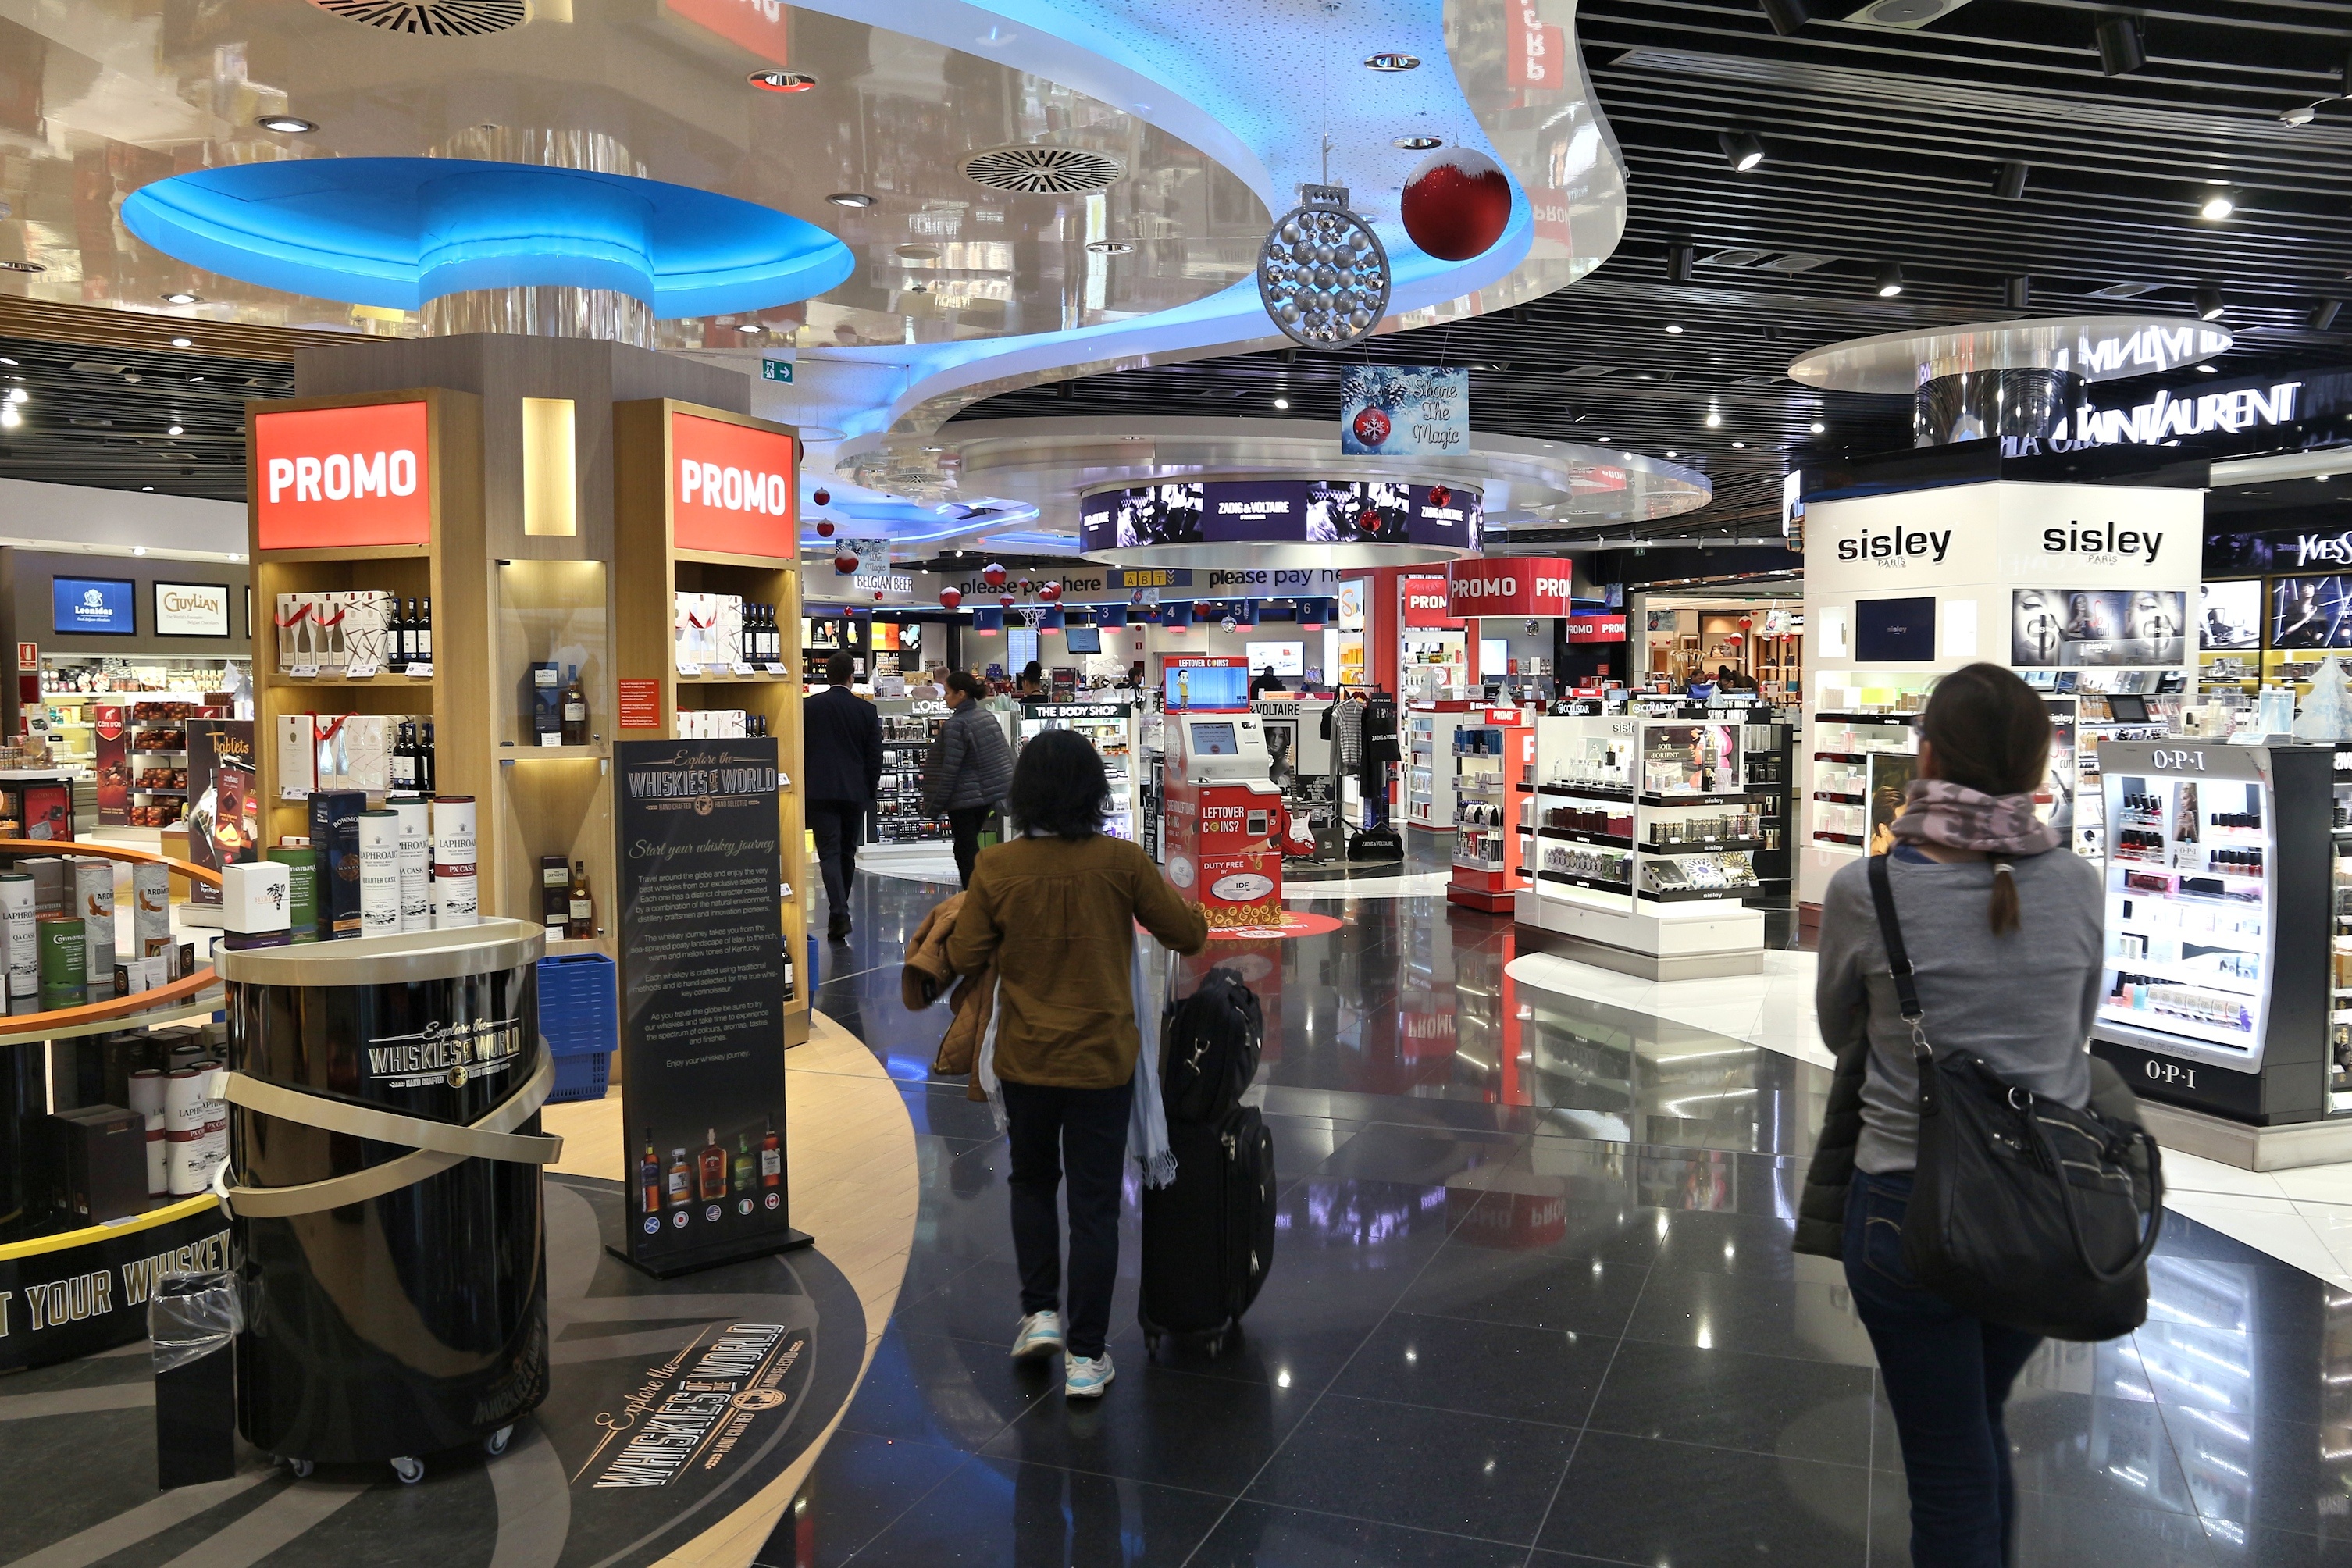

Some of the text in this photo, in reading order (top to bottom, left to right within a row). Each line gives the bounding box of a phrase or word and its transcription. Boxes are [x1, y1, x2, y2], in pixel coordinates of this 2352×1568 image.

[1413, 378, 1458, 398] Share
[1421, 401, 1450, 421] The
[1413, 423, 1459, 449] Magic
[269, 449, 417, 504] PROMO
[681, 458, 786, 516] PROMO
[1838, 526, 1952, 562] sisley
[2044, 520, 2164, 563] sisley
[1878, 558, 1905, 567] PARIS
[2089, 554, 2118, 563] PARIS
[857, 576, 914, 591] BELGIAN BEER
[1127, 576, 1134, 585] A
[1142, 576, 1148, 584] B
[1156, 575, 1163, 584] T
[1210, 569, 1313, 588] please pay
[961, 576, 1101, 596] please pa here
[1452, 576, 1516, 599] PROMO
[1410, 595, 1447, 609] PROM
[75, 605, 113, 615] Leonidas
[1040, 609, 1046, 619] 2
[1102, 607, 1110, 618] 3
[1167, 604, 1175, 616] 4
[1234, 604, 1242, 616] 5
[1303, 603, 1311, 614] 6
[978, 611, 983, 622] 1
[1566, 624, 1593, 634] PROMO
[2086, 642, 2113, 651] sisley
[912, 700, 948, 711] L'ORÉ
[1035, 707, 1057, 717] THE
[1060, 706, 1089, 717] BODY
[1249, 704, 1300, 716] &VOLTAIRE
[1493, 711, 1513, 720] PROMO
[1613, 723, 1635, 734] sisle
[205, 732, 249, 754] Tablets
[672, 749, 734, 770] Explore the
[1651, 751, 1680, 760] d'ORIENT
[628, 769, 707, 798] WHISKIES
[720, 767, 775, 793] WORLD
[672, 802, 692, 811] CRAFTED
[726, 799, 747, 807] SELECTED
[1203, 806, 1245, 818] LEFTOVER
[440, 839, 476, 848] LAPHROAI
[629, 839, 775, 861] Start your whiskey journey
[639, 875, 658, 883] Travel
[659, 873, 682, 882] around
[695, 871, 712, 880] globe
[727, 869, 743, 878] enjoy
[691, 889, 713, 898] distinct
[715, 888, 743, 896] character
[744, 885, 768, 893] created
[422, 1017, 488, 1041] Explore the
[368, 1026, 520, 1074] WHISKIES WORLD
[25, 1270, 112, 1331] YOUR
[593, 1392, 732, 1489] WHISKIES
[687, 1323, 785, 1379] WORLD
[594, 1381, 665, 1431] Explore
